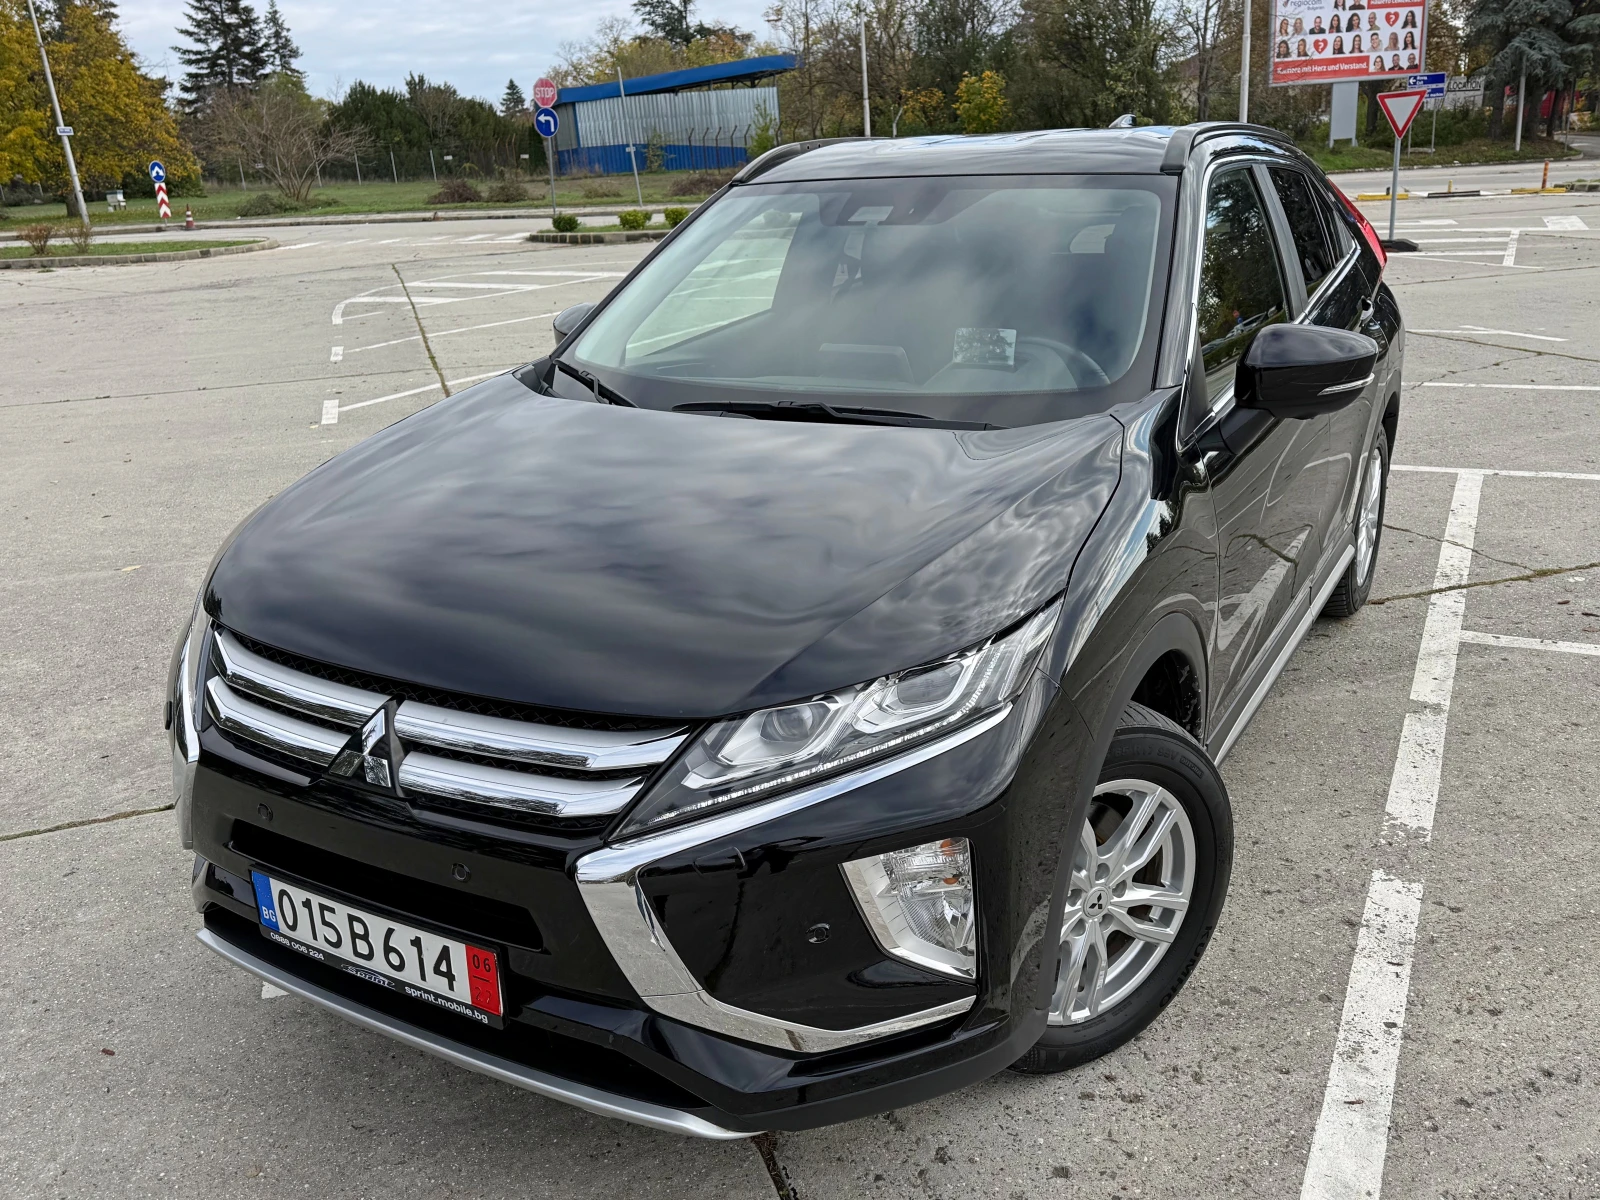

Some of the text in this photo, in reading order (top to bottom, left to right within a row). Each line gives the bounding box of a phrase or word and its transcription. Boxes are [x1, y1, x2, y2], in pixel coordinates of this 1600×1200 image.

[1312, 64, 1327, 72] Herz
[1340, 61, 1368, 71] Verstand.
[535, 87, 555, 98] STOP
[262, 906, 276, 922] BG
[472, 954, 491, 973] 06
[1159, 925, 1213, 1008] KUMHO
[404, 986, 489, 1024] sprint.mobile.bg
